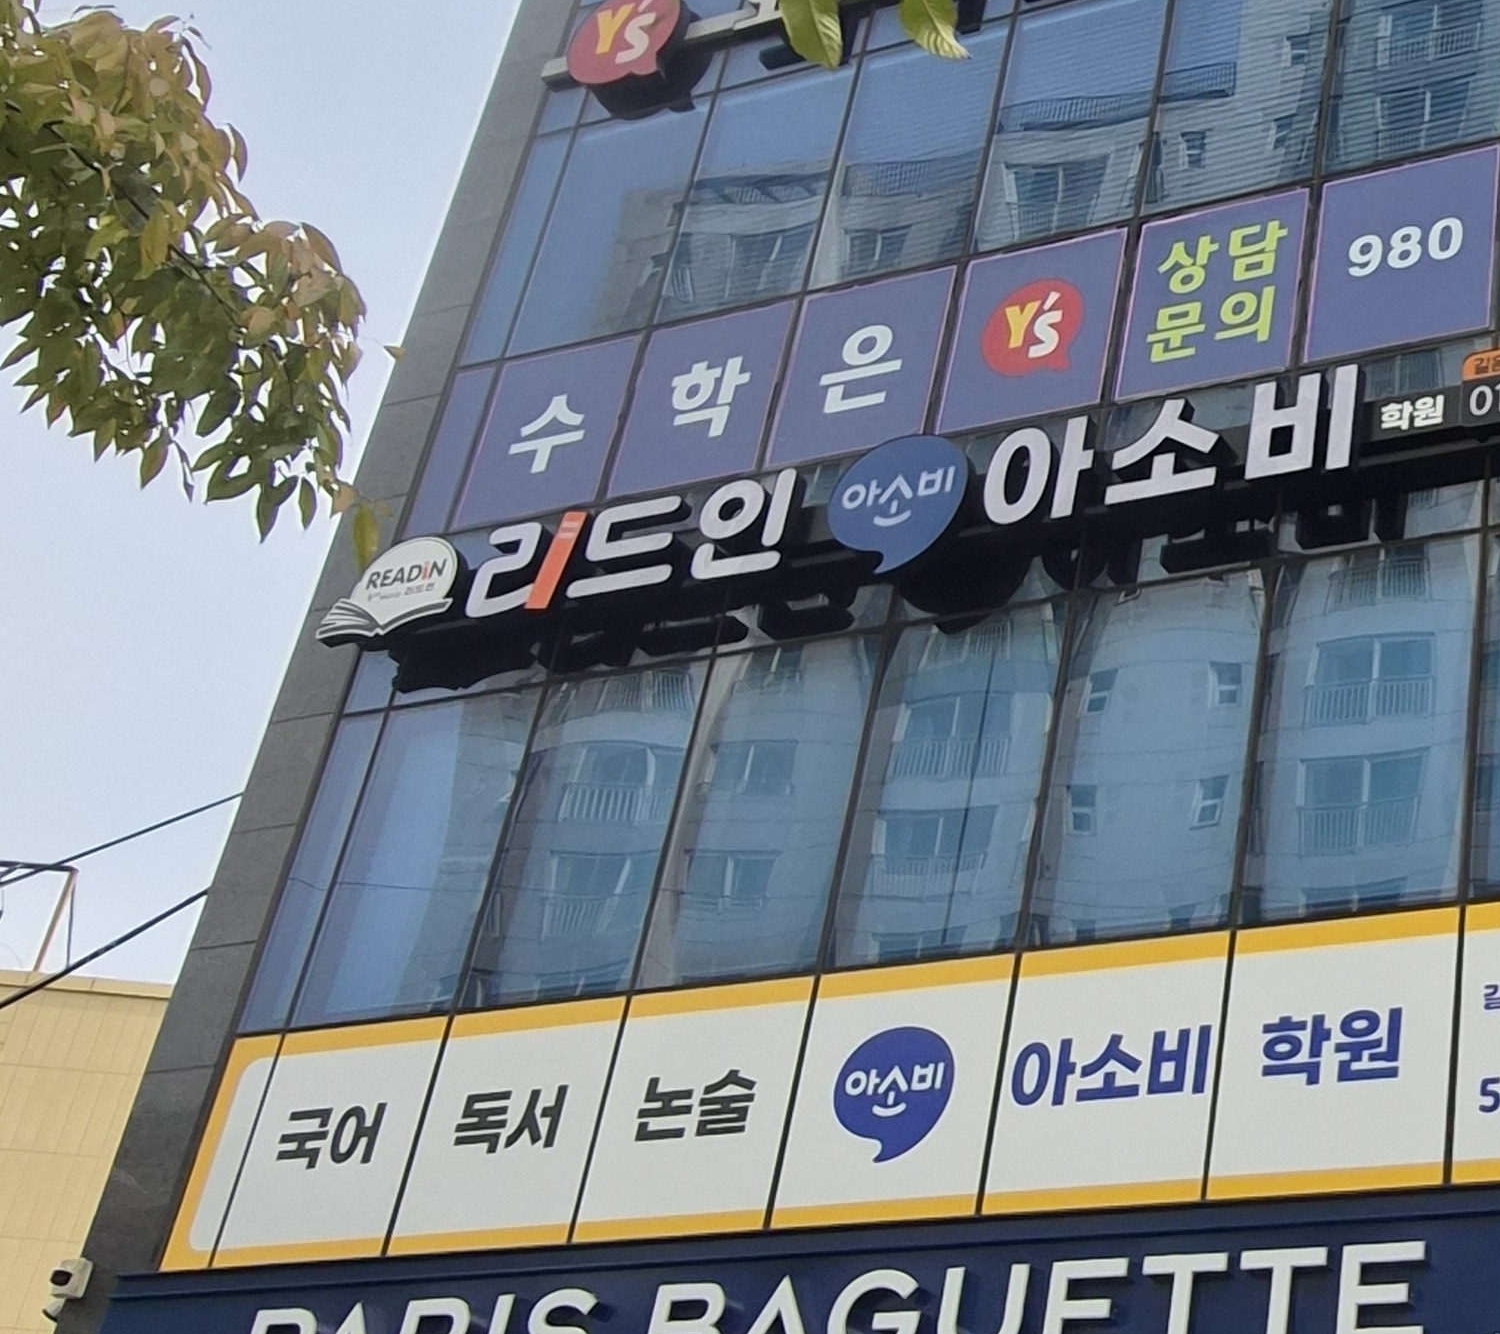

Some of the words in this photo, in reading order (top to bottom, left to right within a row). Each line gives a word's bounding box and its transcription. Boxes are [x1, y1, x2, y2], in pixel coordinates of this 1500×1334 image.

[1157, 219, 1289, 295] 상담
[1347, 217, 1464, 278] 980
[1003, 290, 1063, 359] Y's
[1145, 285, 1276, 364] 문의
[464, 467, 797, 619] 리드인
[840, 465, 956, 528] 아소비
[984, 364, 1361, 526] 아소비
[1380, 395, 1445, 431] 학원
[275, 1101, 388, 1170] 국어
[453, 1083, 570, 1155] 독서
[634, 1068, 758, 1143] 논술
[843, 1061, 946, 1118] 아소비
[1010, 1024, 1212, 1108] 아소비
[1259, 1007, 1404, 1087] 학원
